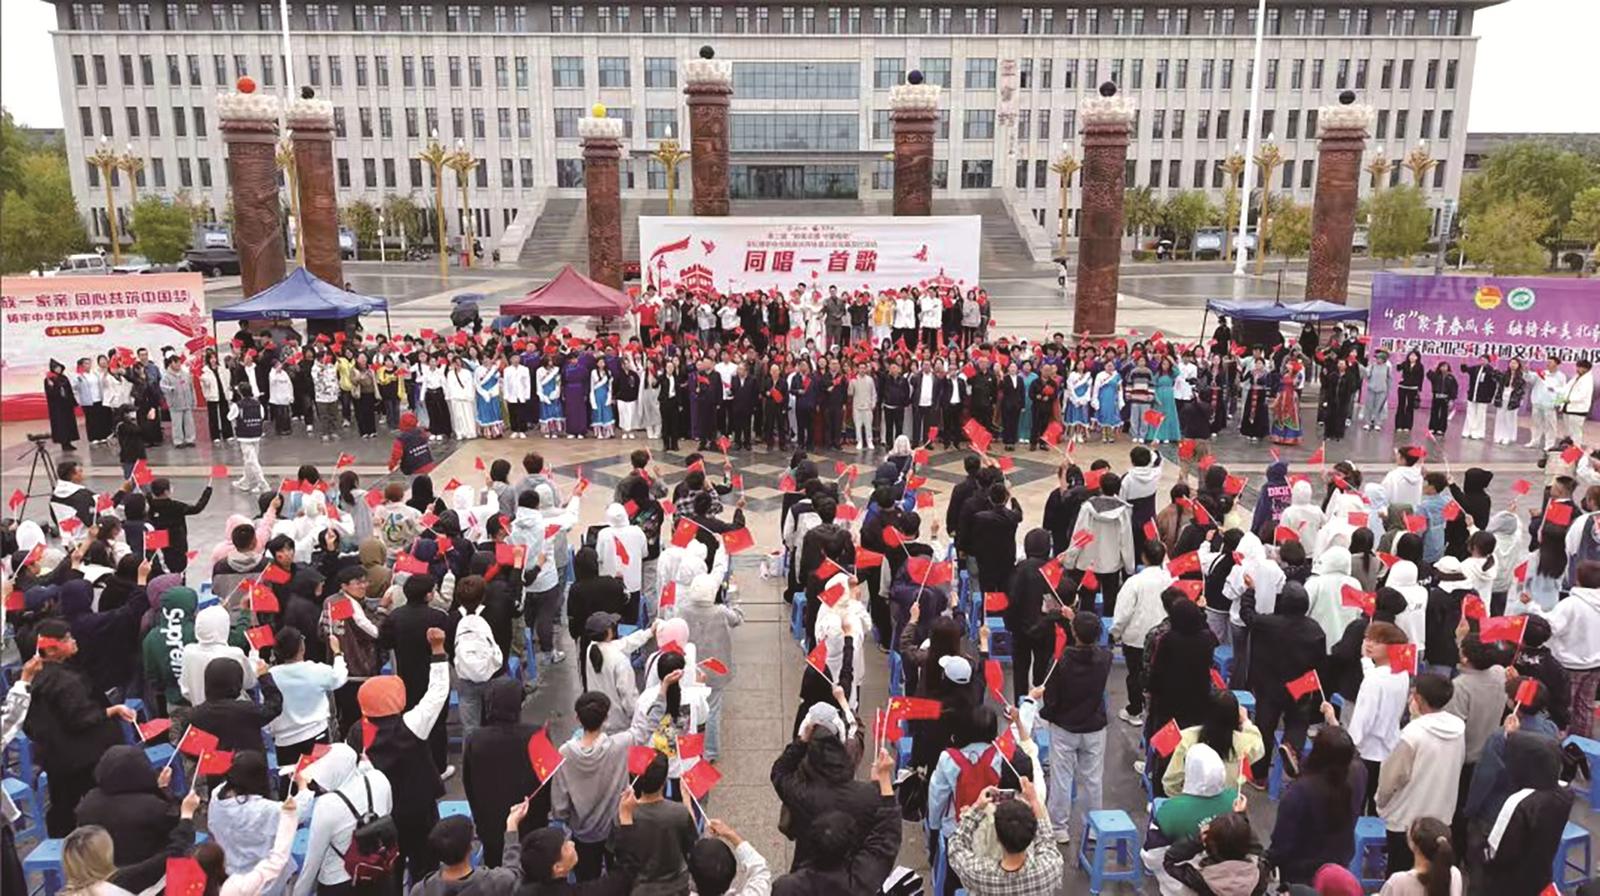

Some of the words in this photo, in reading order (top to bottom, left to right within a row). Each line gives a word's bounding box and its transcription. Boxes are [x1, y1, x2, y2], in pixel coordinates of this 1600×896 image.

[744, 250, 877, 272] 同唱一首歌
[75, 290, 188, 306] 同心共筑中国梦
[7, 309, 138, 323] 铸牢中华民族共同体意识
[160, 607, 185, 678] Suprem
